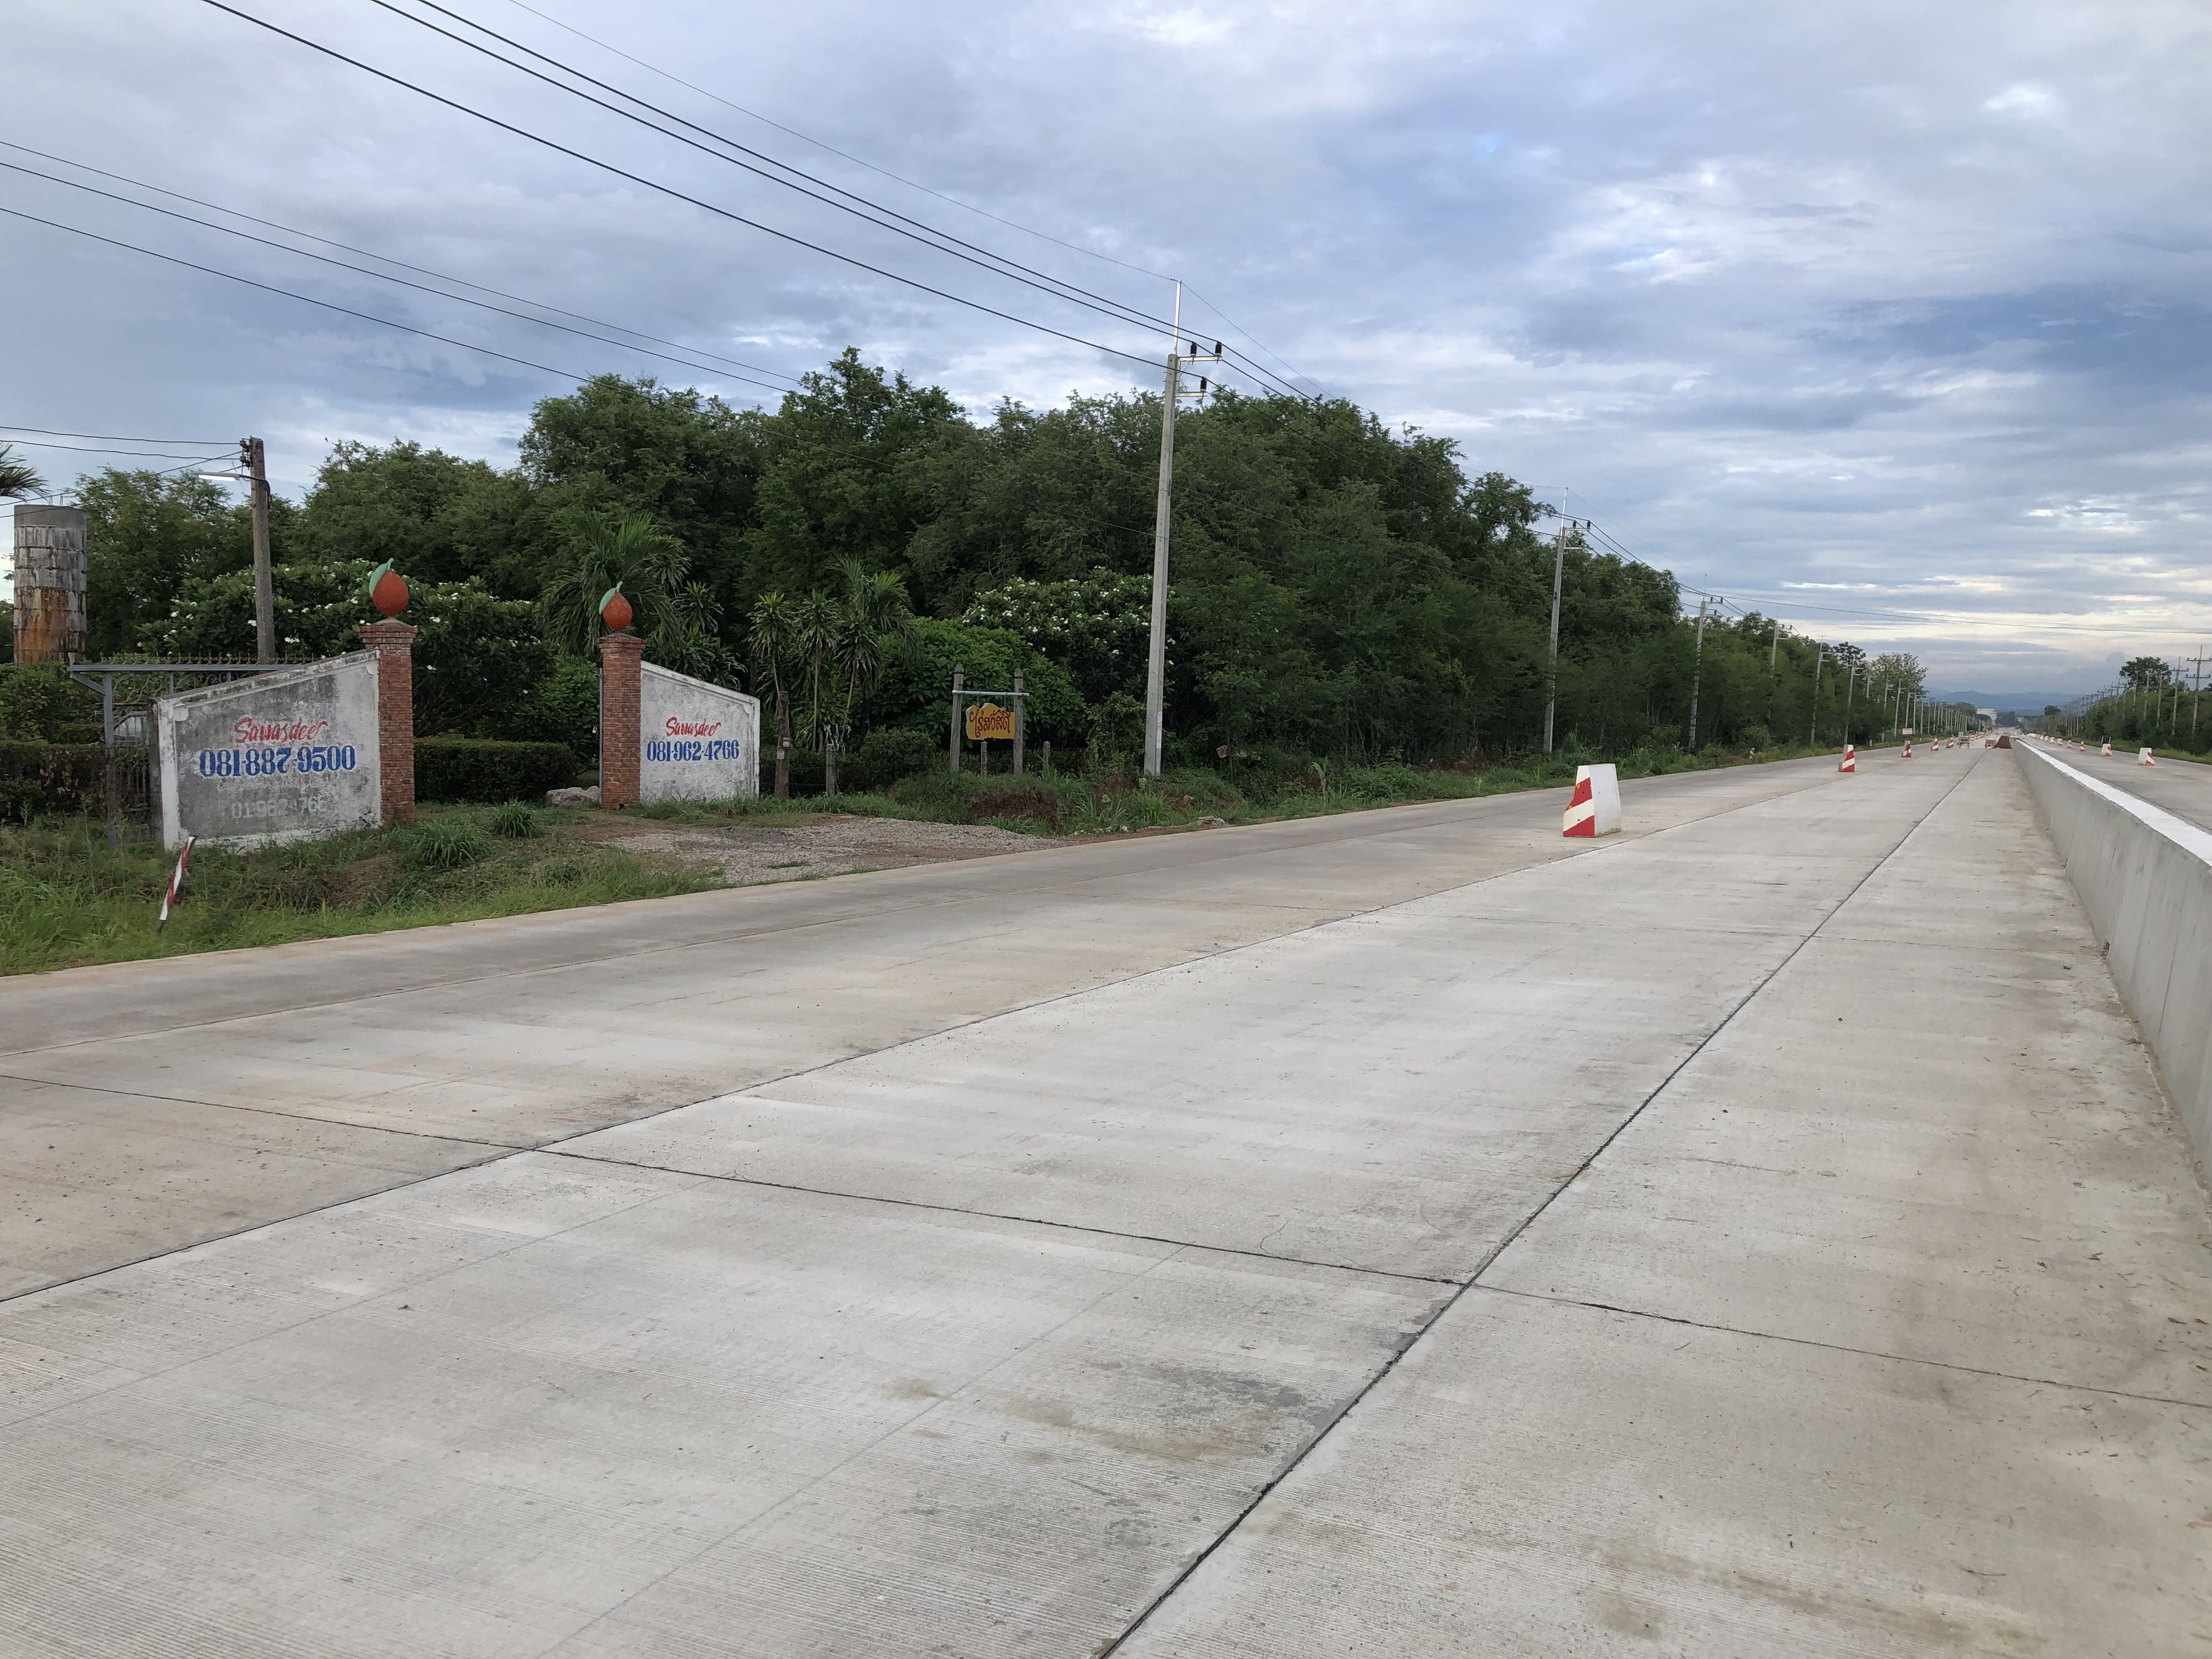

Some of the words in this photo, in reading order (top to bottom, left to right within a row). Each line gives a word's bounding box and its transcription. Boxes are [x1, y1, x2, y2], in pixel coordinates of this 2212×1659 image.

[969, 708, 1011, 738] ไร่สวัสดี
[200, 745, 356, 777] 081-887-9500
[647, 740, 739, 761] 081-962-4766
